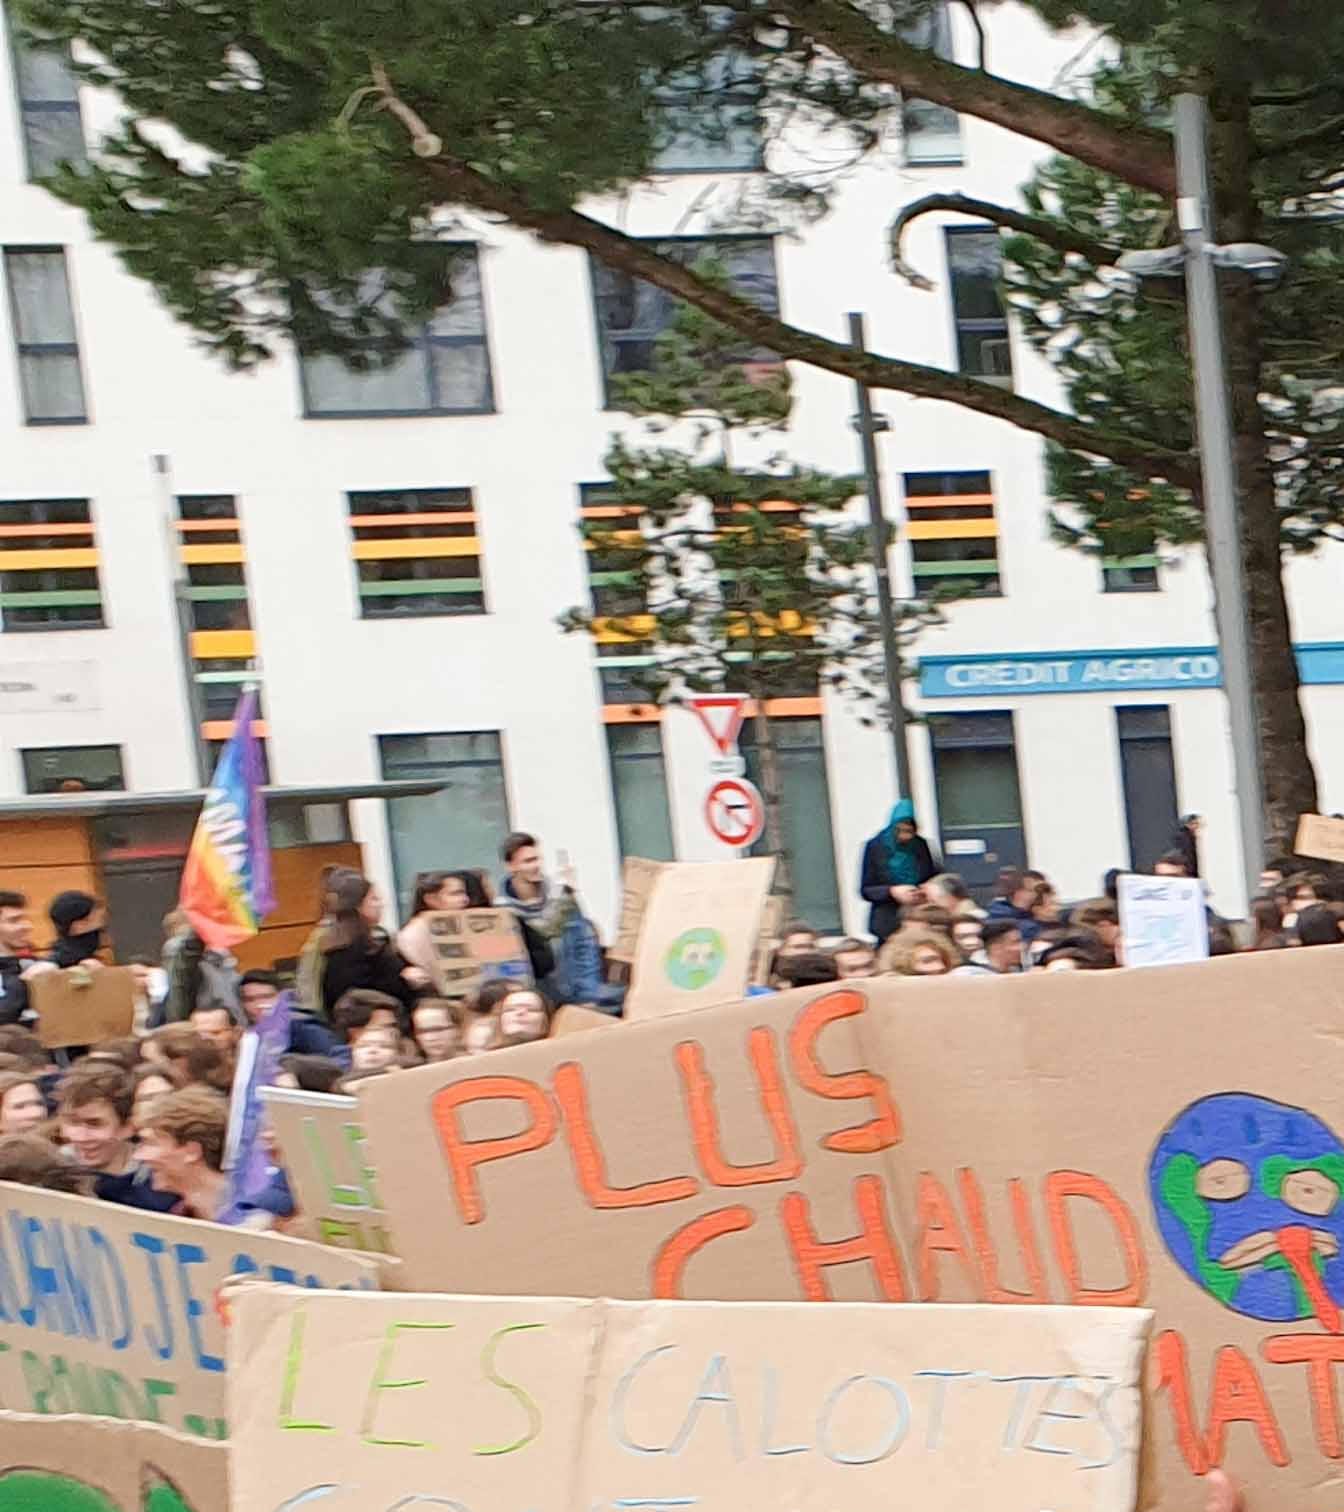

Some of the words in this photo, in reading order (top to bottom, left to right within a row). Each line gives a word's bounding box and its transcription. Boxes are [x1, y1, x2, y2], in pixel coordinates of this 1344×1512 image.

[1080, 656, 1220, 682] AGRICO
[431, 987, 902, 1225] PLUS
[649, 1166, 1150, 1306] CHAUD
[277, 1310, 549, 1457] LES
[610, 1342, 1128, 1471] CALOTTES
